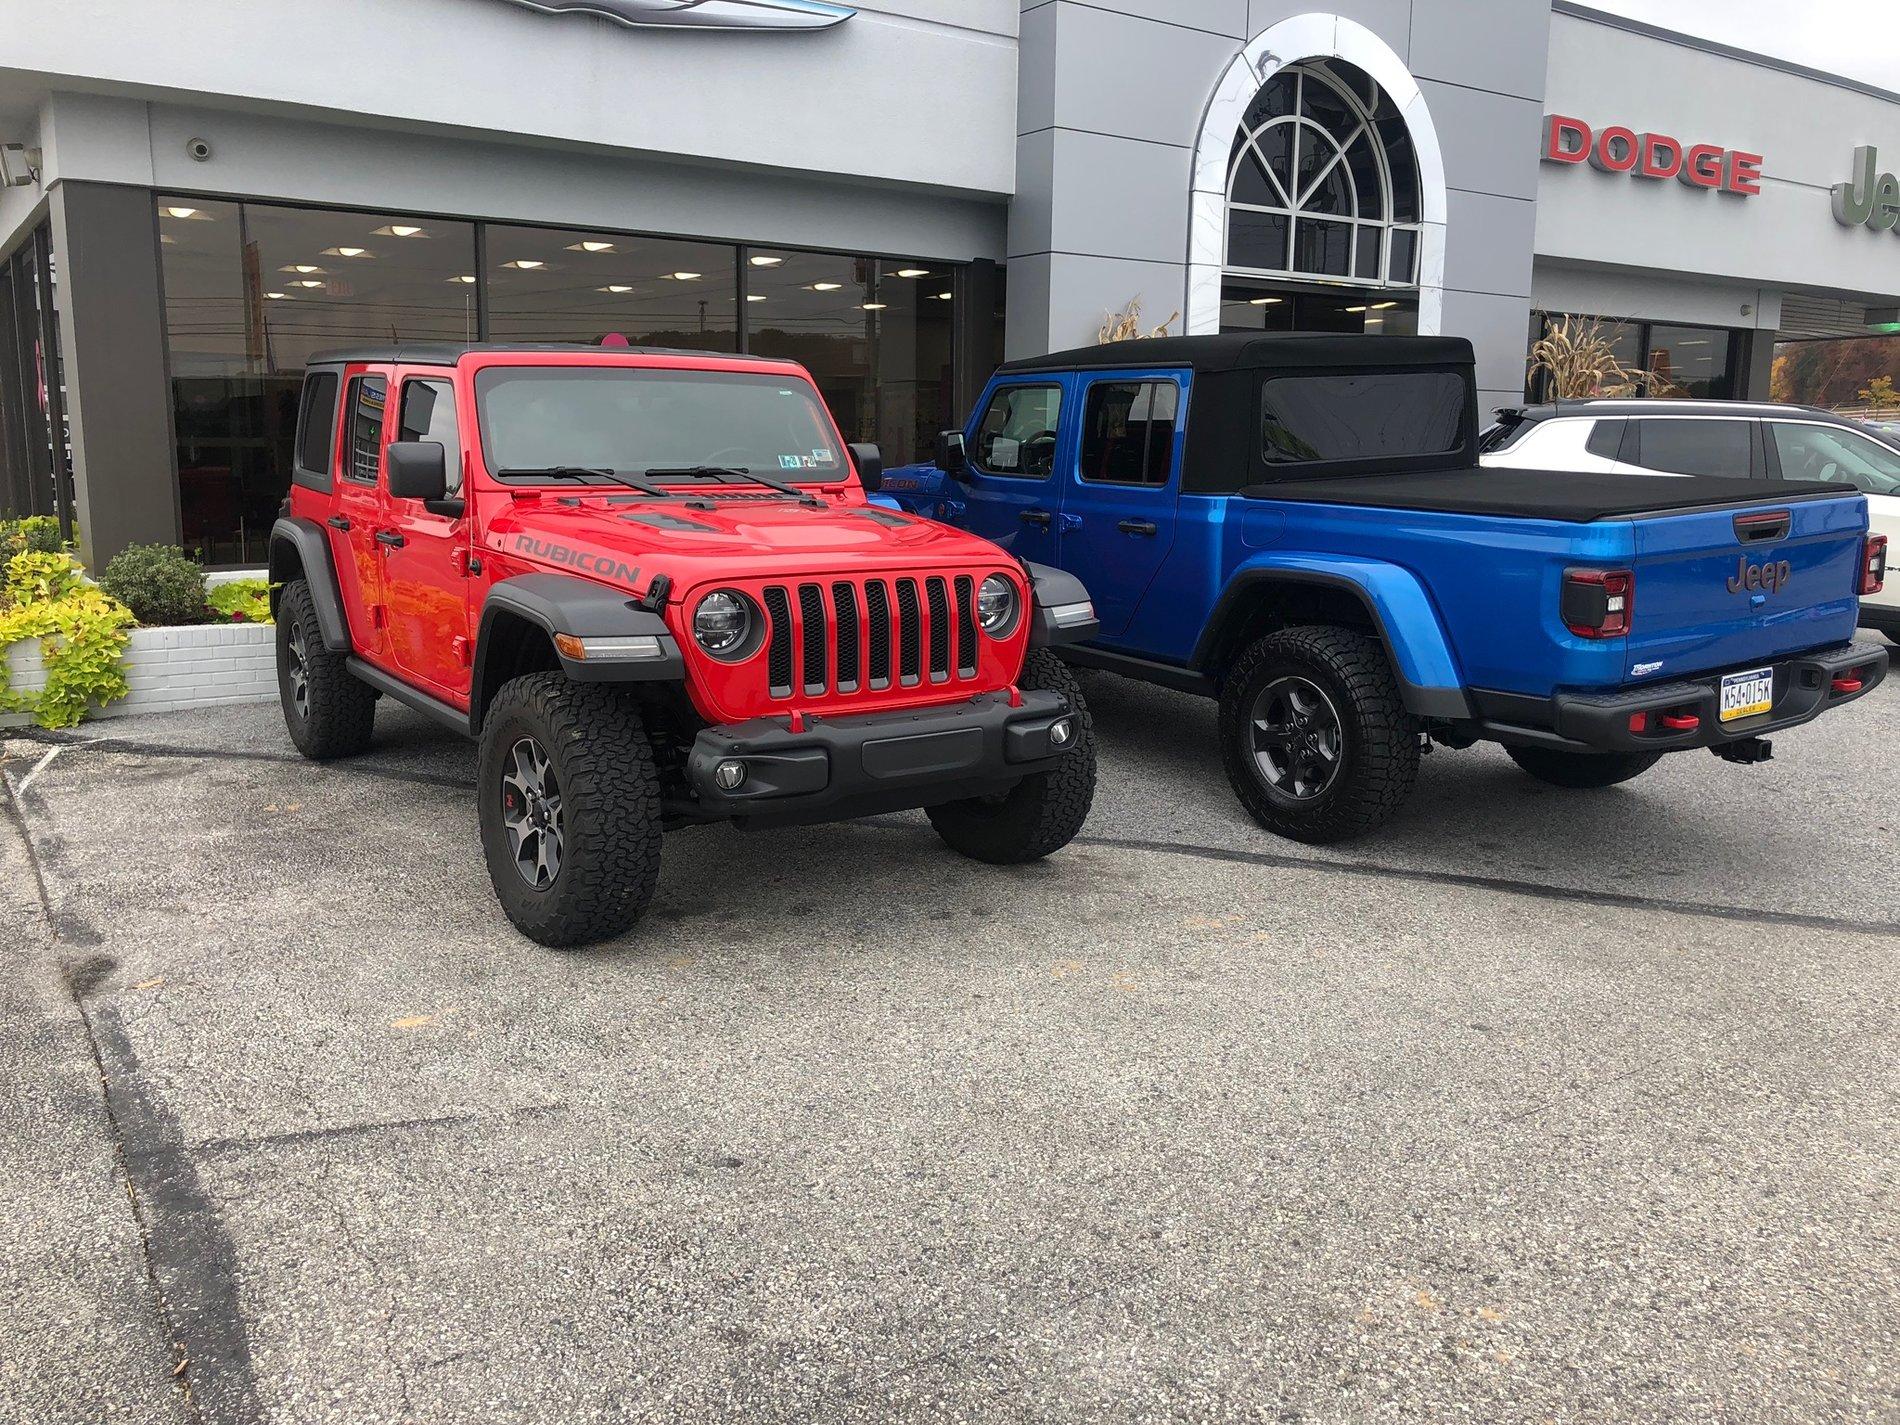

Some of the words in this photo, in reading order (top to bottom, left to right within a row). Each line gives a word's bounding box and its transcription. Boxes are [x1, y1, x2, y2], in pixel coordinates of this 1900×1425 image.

[1541, 114, 1763, 196] DODGE
[1831, 145, 1900, 229] Je
[515, 535, 640, 584] RUBICON
[1727, 556, 1791, 594] Jeep
